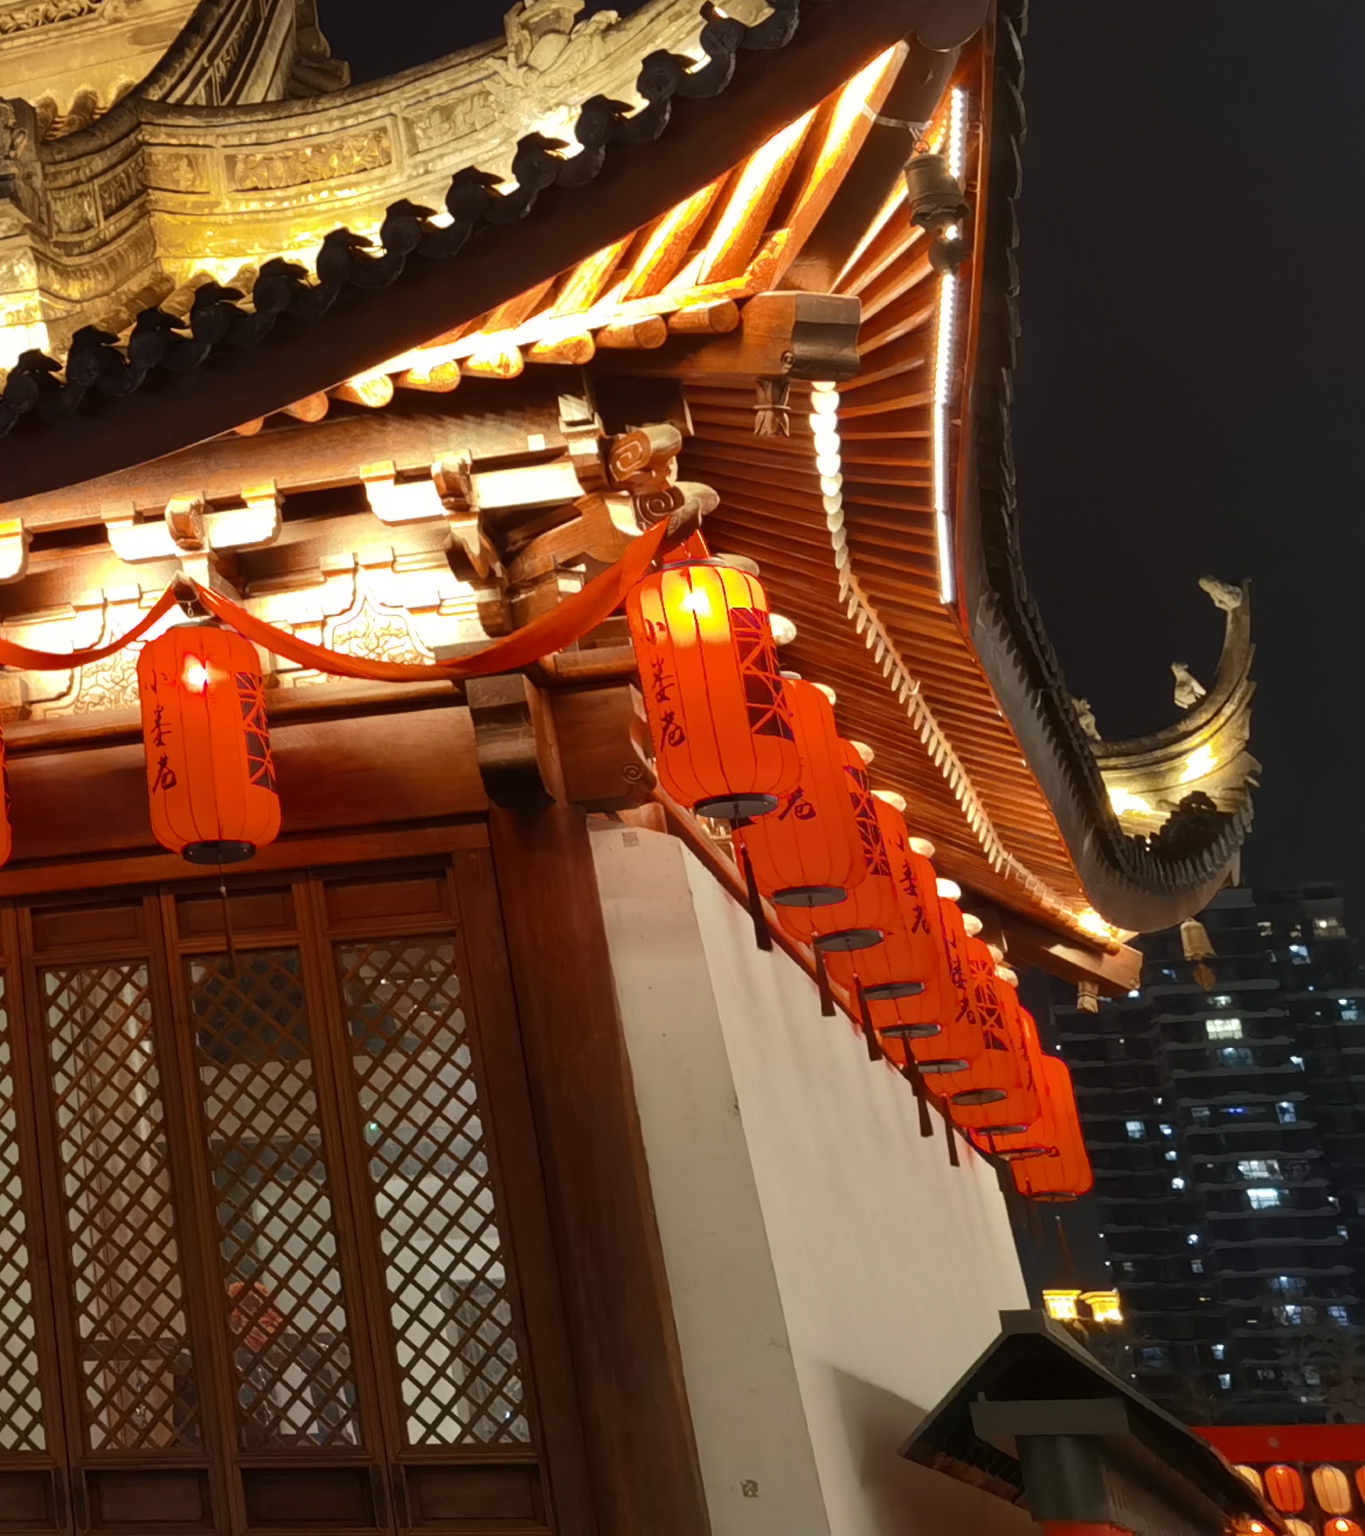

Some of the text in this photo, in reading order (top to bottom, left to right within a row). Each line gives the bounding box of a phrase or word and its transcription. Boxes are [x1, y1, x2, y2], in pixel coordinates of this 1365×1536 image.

[145, 671, 177, 794] 小娄巷
[641, 618, 686, 752] 小娄巷
